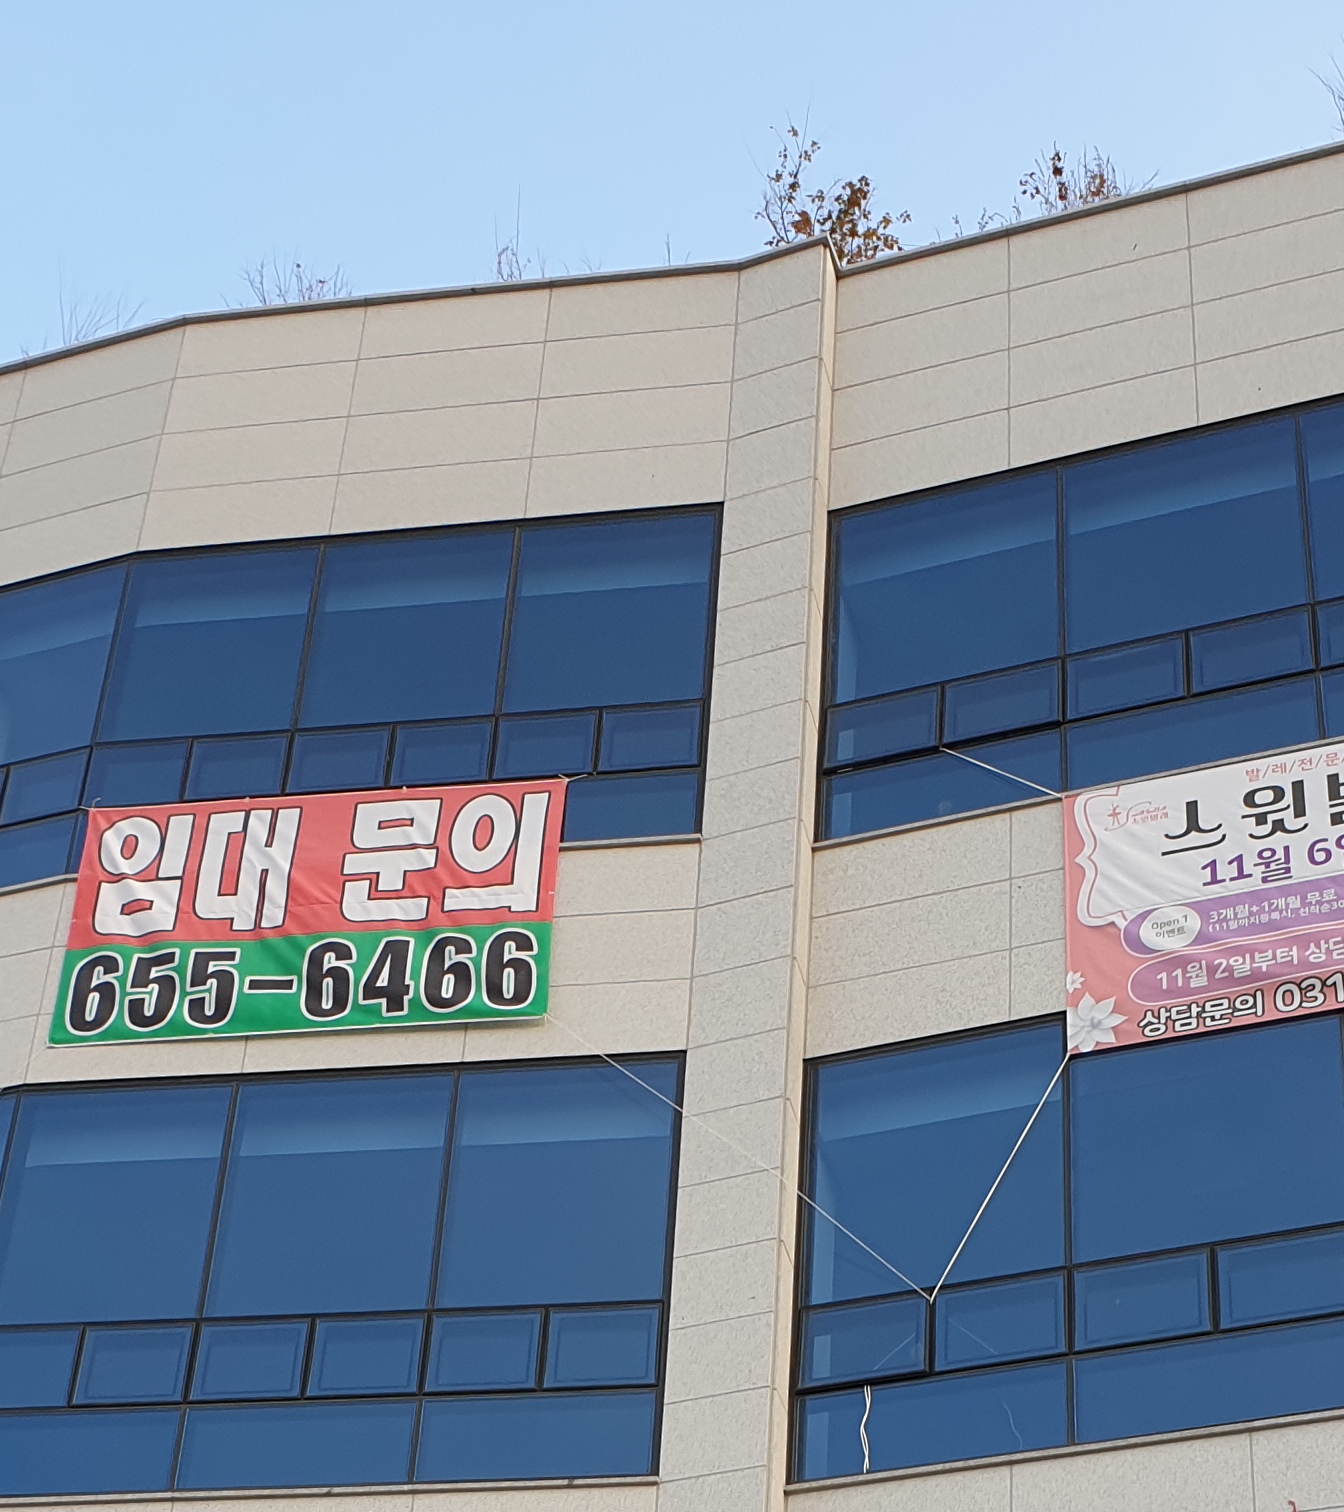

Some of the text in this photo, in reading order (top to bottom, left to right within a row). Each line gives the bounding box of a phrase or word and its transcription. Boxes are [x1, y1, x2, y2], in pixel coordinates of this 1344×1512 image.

[92, 790, 551, 938] 임대 문의
[1201, 845, 1293, 887] 11월
[1306, 888, 1338, 904] 무료
[1155, 926, 1187, 939] 이벤트
[65, 927, 538, 1036] 655-6466
[1156, 959, 1208, 990] 11월
[1213, 947, 1298, 980] 2일부터
[1137, 987, 1264, 1038] 상담문의
